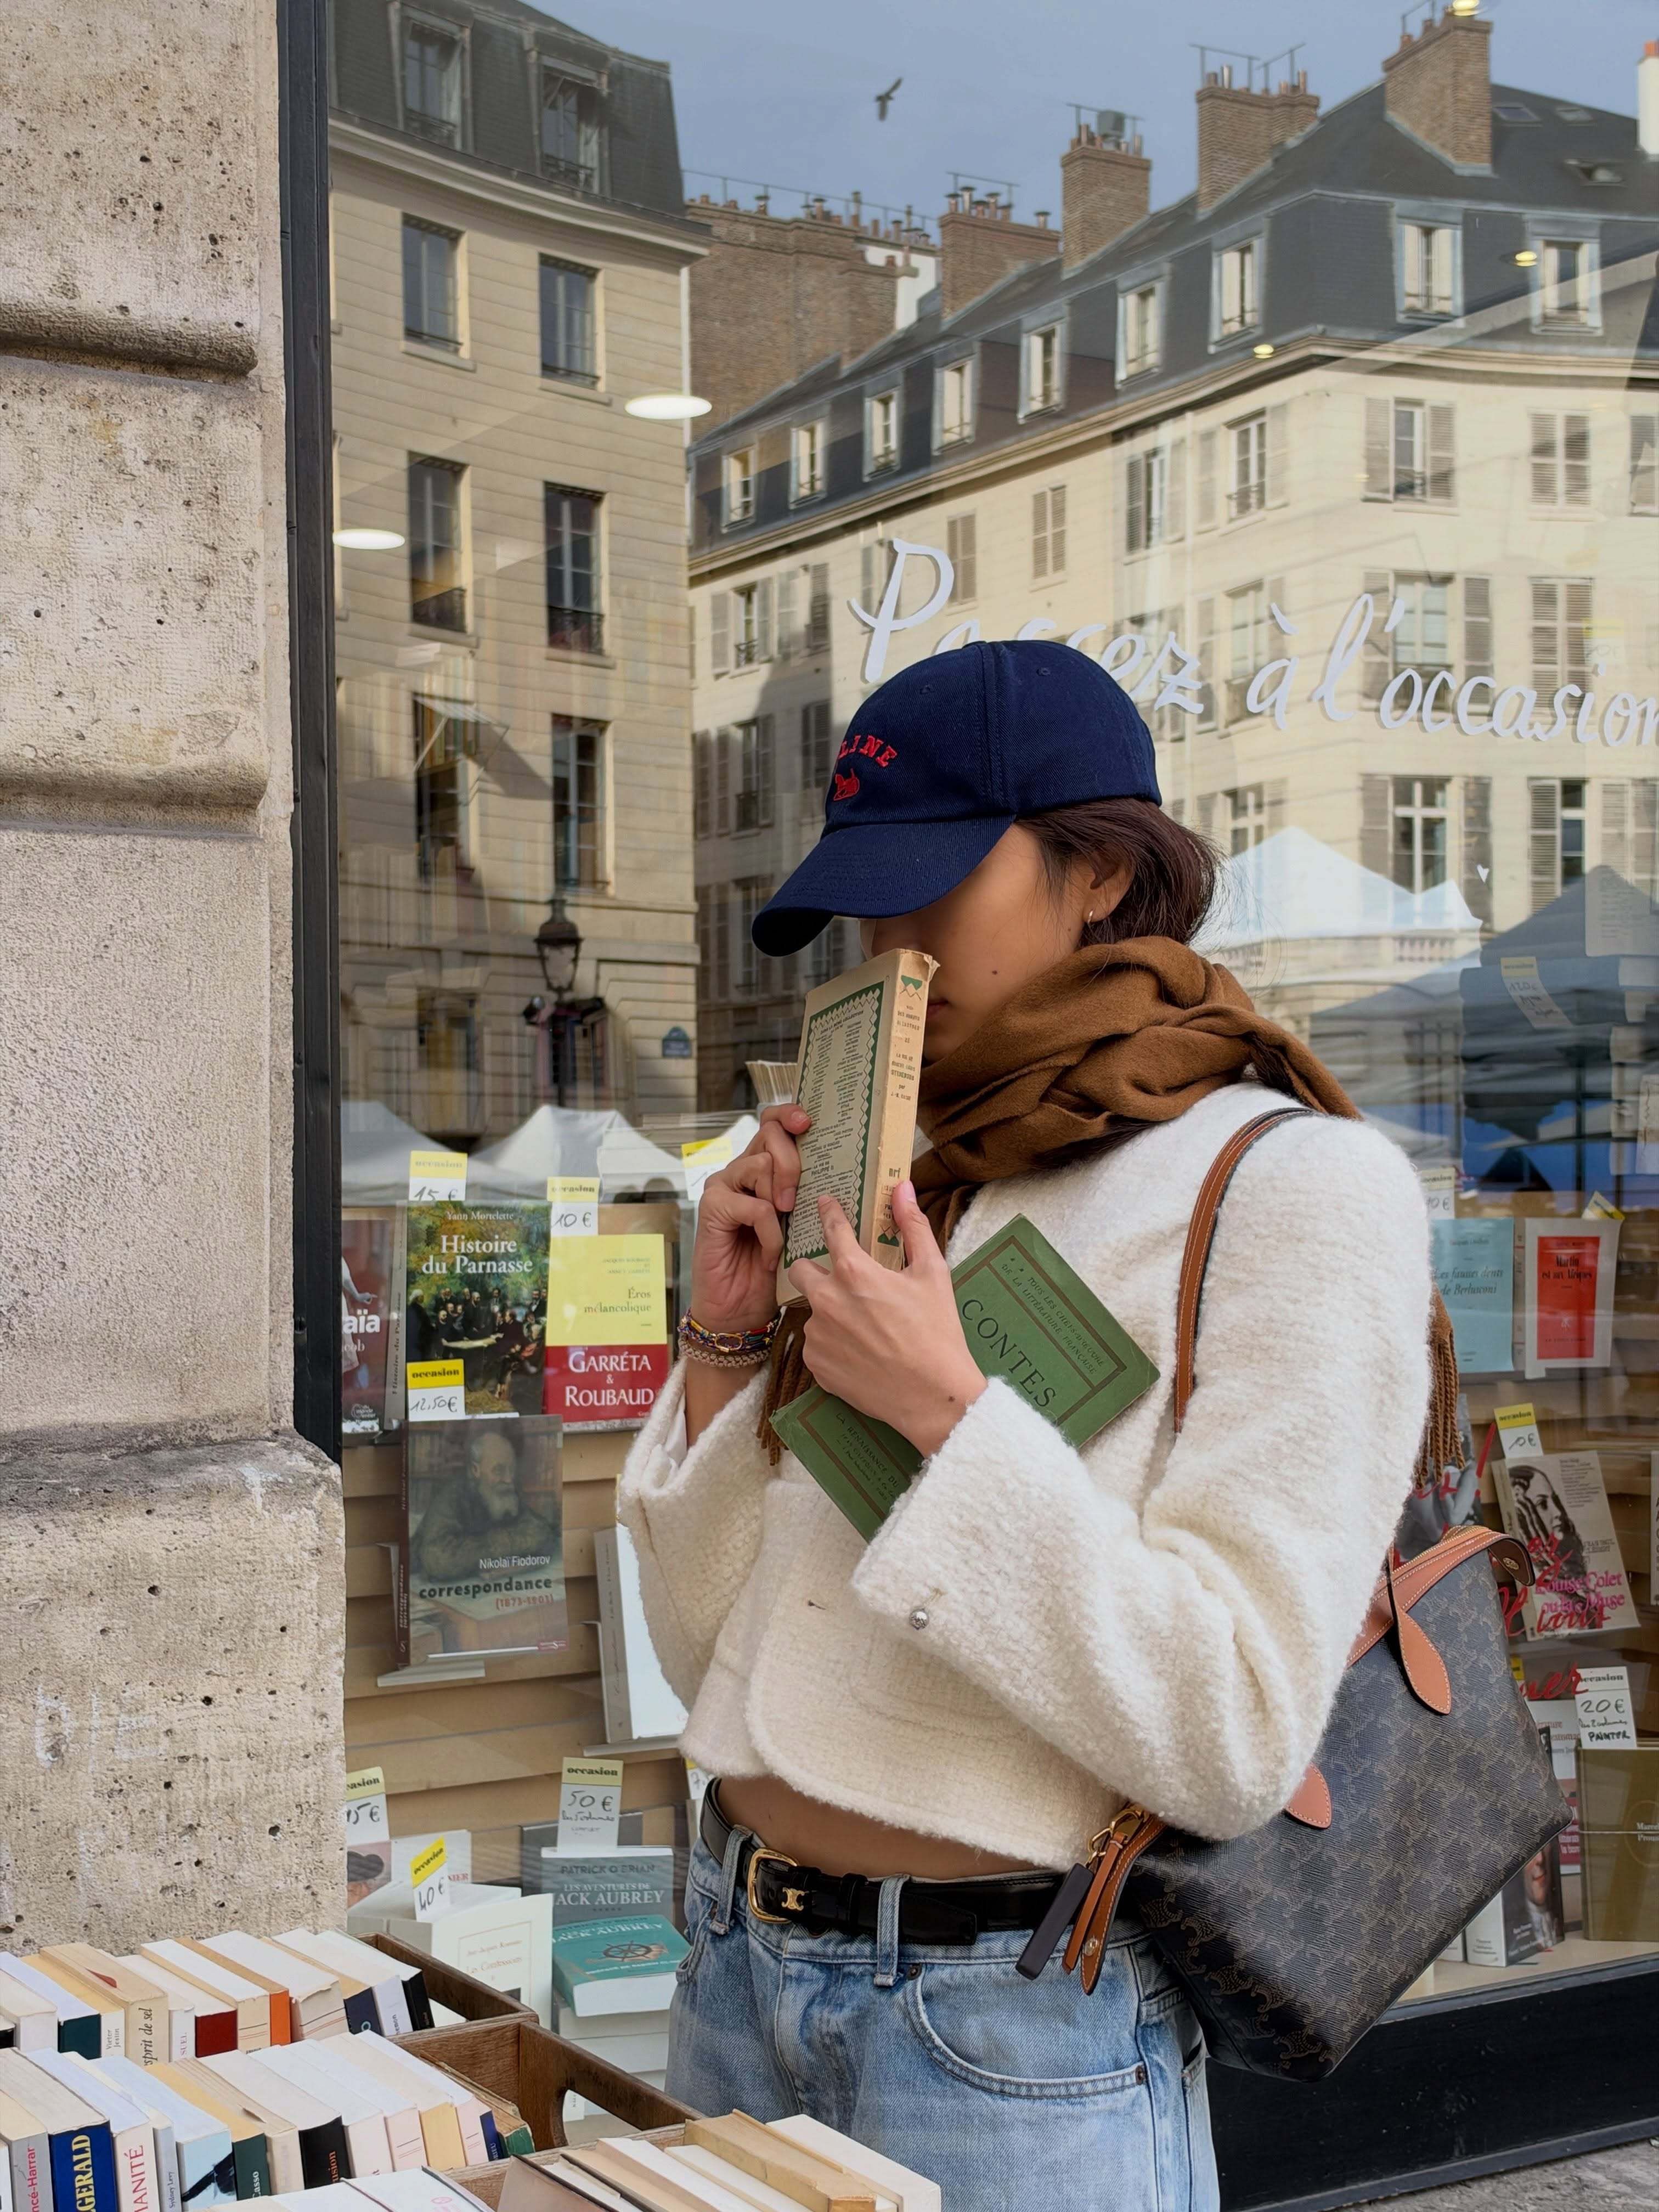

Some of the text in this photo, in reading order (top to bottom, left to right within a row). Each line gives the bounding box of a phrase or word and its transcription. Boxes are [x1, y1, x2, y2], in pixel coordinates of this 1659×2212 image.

[1246, 602, 1299, 730] à
[889, 1167, 901, 1178] nrf
[1442, 1197, 1450, 1211] €
[446, 1211, 468, 1221] Yann
[552, 1212, 592, 1228] 10 €
[441, 1234, 517, 1254] Histoire
[422, 1254, 534, 1274] du Parnasse
[1556, 1255, 1579, 1268] Martin
[1434, 1267, 1449, 1279] Les
[1481, 1265, 1504, 1278] dents
[628, 1285, 651, 1299] Éros
[1027, 1276, 1045, 1295] TOUS
[1043, 1295, 1057, 1310] LES
[1440, 1283, 1497, 1296] de Berlusconi
[584, 1301, 651, 1317] mélancolique
[1001, 1263, 1097, 1375] DE LA LITTÉRATURE FRANÇAISE
[962, 1299, 1057, 1407] CONTES
[568, 1350, 652, 1373] GARRÉTA
[412, 1368, 460, 1379] occasion
[606, 1374, 614, 1384] &
[565, 1385, 655, 1407] ROUBAUD
[1499, 1411, 1532, 1421] occasion
[1527, 1432, 1537, 1447] €
[847, 1426, 888, 1474] RENAISSANCE
[888, 1475, 900, 1489] DU
[479, 1555, 551, 1570] Nikolaï Fiodorov
[419, 1576, 552, 1600] correspondance
[1536, 1570, 1623, 1595] Louise Colet
[1543, 1601, 1559, 1613] ou
[1576, 1591, 1626, 1613] Muse
[1581, 1699, 1625, 1714] 20 €
[567, 1767, 618, 1776] occasion
[568, 1790, 613, 1812] 50 €
[369, 1805, 380, 1823] €
[414, 1848, 444, 1875] occasion
[560, 1865, 607, 1875] PATRICK
[419, 1876, 446, 1911] 40 €
[563, 1882, 651, 1892] LES AVENTURES DE
[594, 1889, 665, 1905] AUBREY
[138, 2007, 154, 2022] sel
[138, 2023, 154, 2036] de
[168, 2171, 176, 2186] Levy
